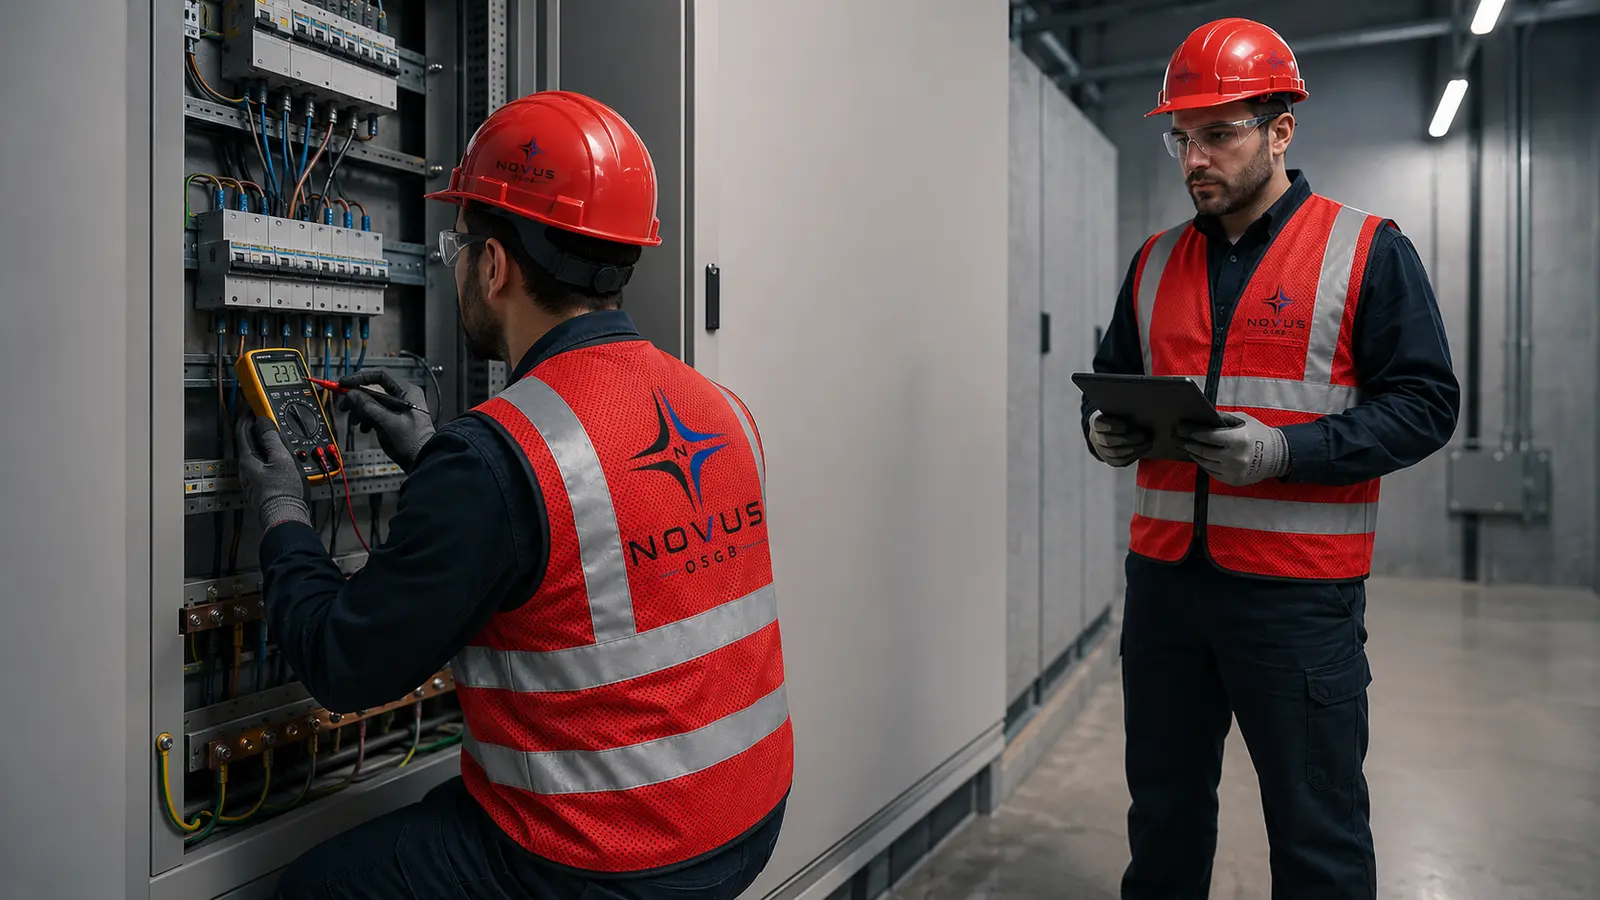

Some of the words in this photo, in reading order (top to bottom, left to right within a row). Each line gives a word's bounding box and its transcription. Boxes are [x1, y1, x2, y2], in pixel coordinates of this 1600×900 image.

[496, 160, 555, 180] NOVUS
[1247, 318, 1306, 329] NOVUS
[673, 444, 688, 459] N
[628, 501, 764, 566] NOVUS
[685, 545, 737, 574] OSGB
